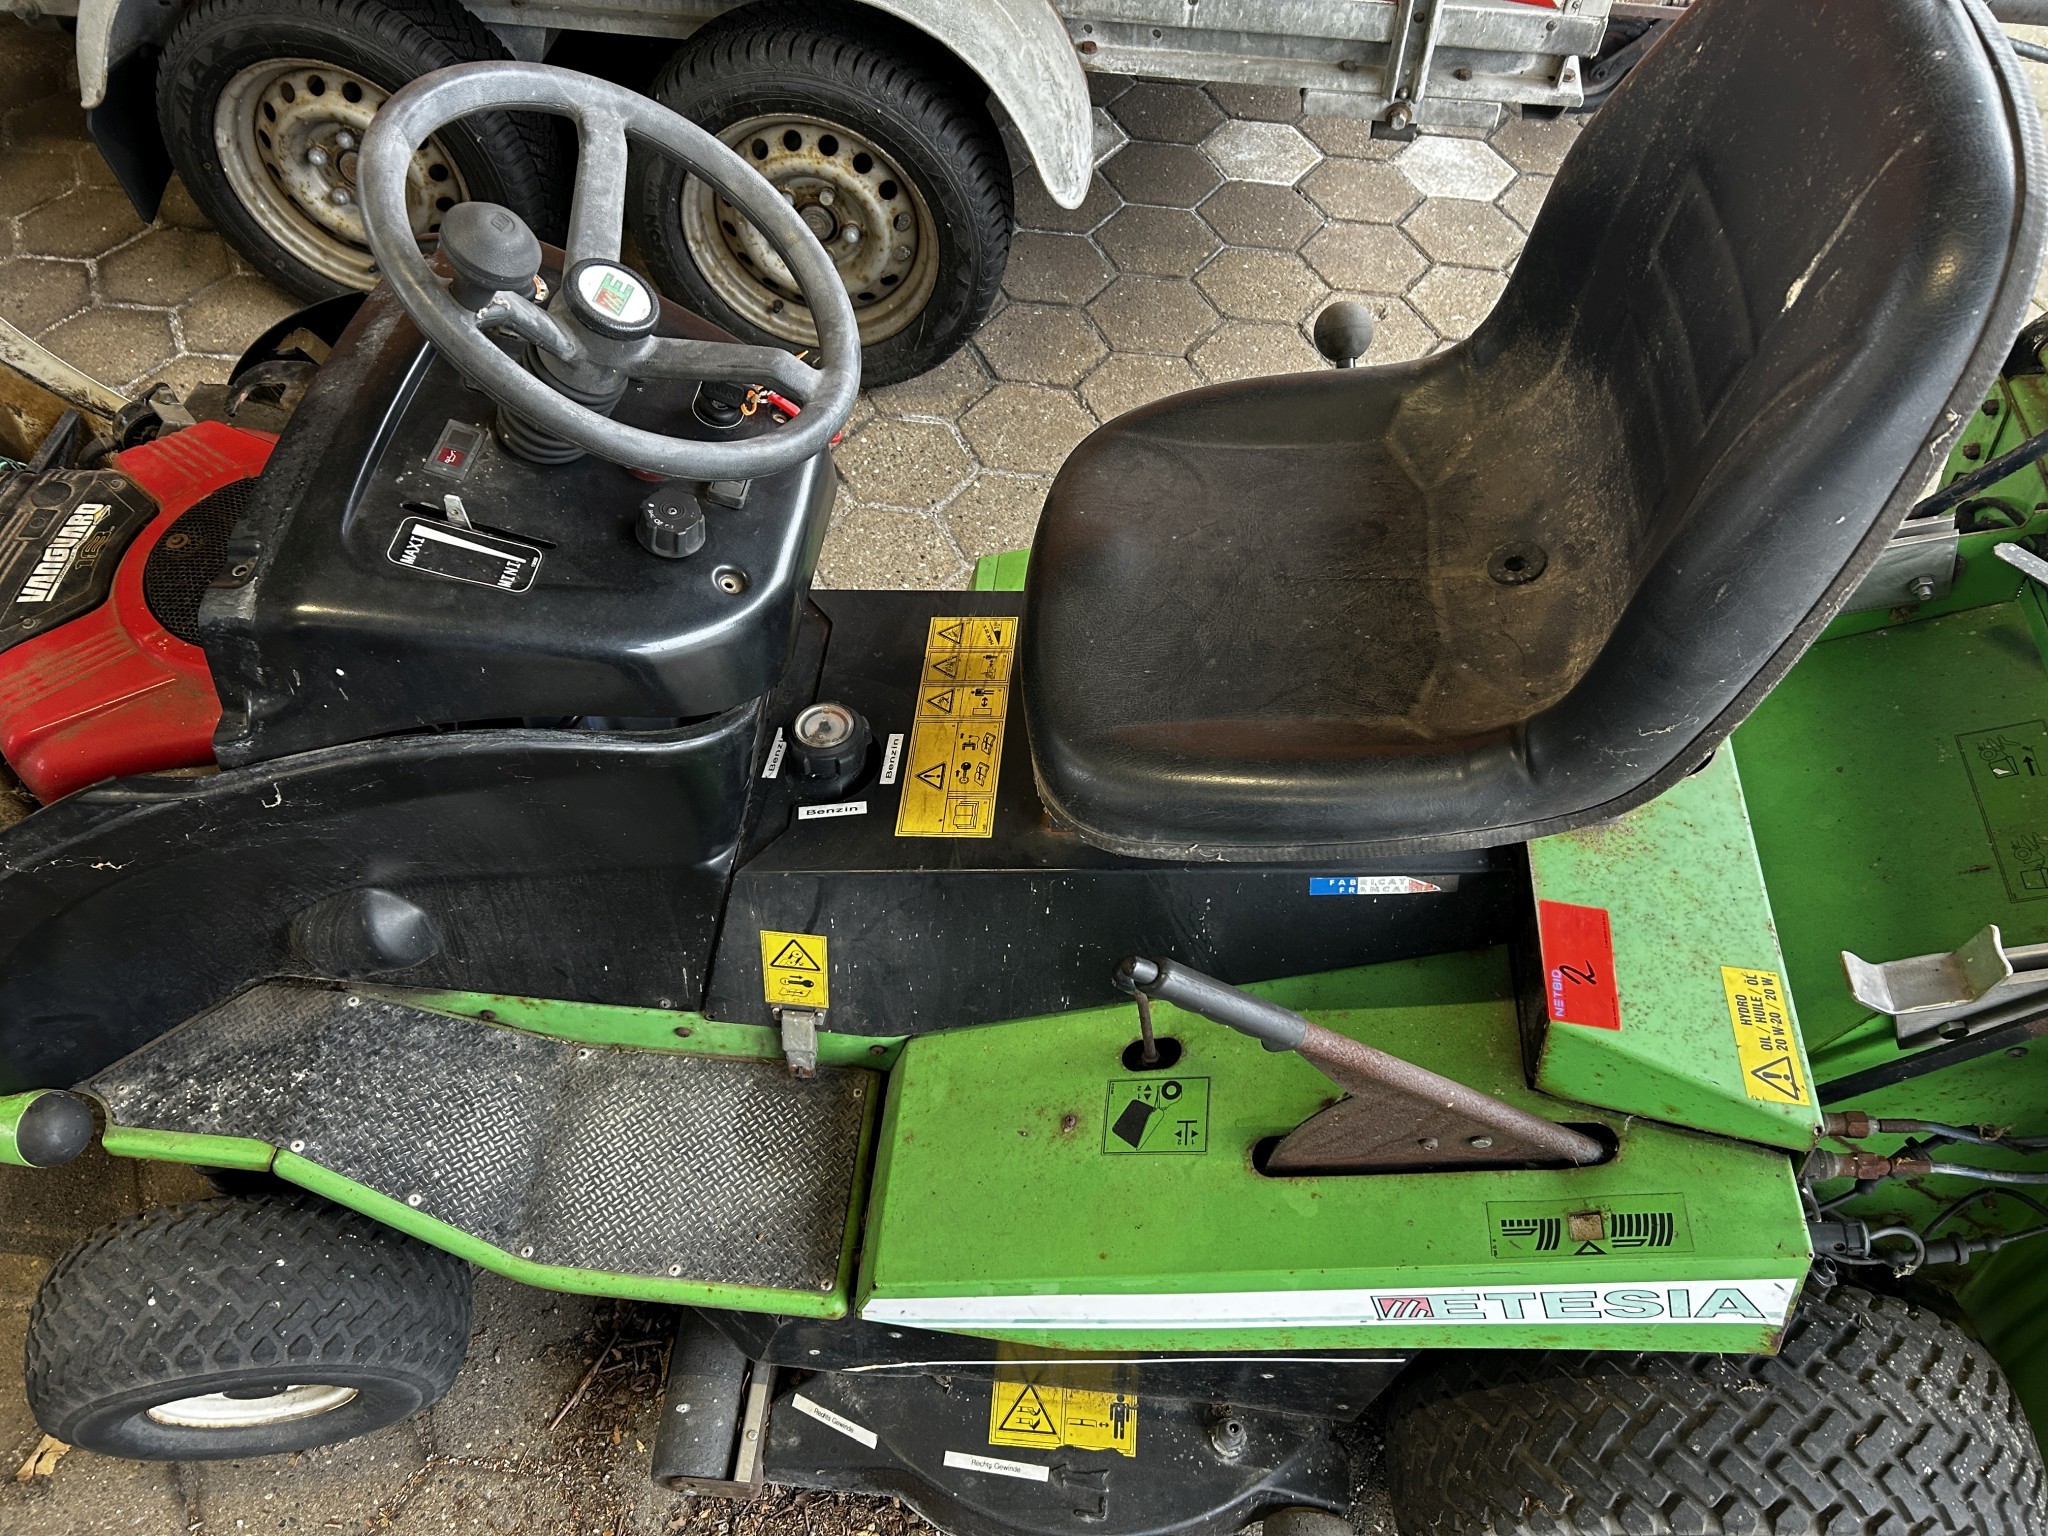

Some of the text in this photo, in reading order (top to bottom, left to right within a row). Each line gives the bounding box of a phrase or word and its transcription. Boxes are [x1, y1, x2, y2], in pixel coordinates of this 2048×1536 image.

[16, 503, 105, 602] VANGUARD
[400, 535, 426, 565] MAXI
[497, 560, 521, 589] MINI
[886, 738, 899, 779] Benzin
[806, 805, 858, 816] Benzin
[1551, 969, 1565, 1017] NETBID
[1763, 989, 1777, 1001] 20
[1735, 994, 1753, 1026] HYDRO
[1750, 996, 1767, 1024] HUILE
[1759, 1036, 1773, 1051] OIL
[1776, 1038, 1789, 1052] 20
[1428, 1288, 1766, 1320] ETESIA
[993, 1462, 1021, 1473] Gewinde
